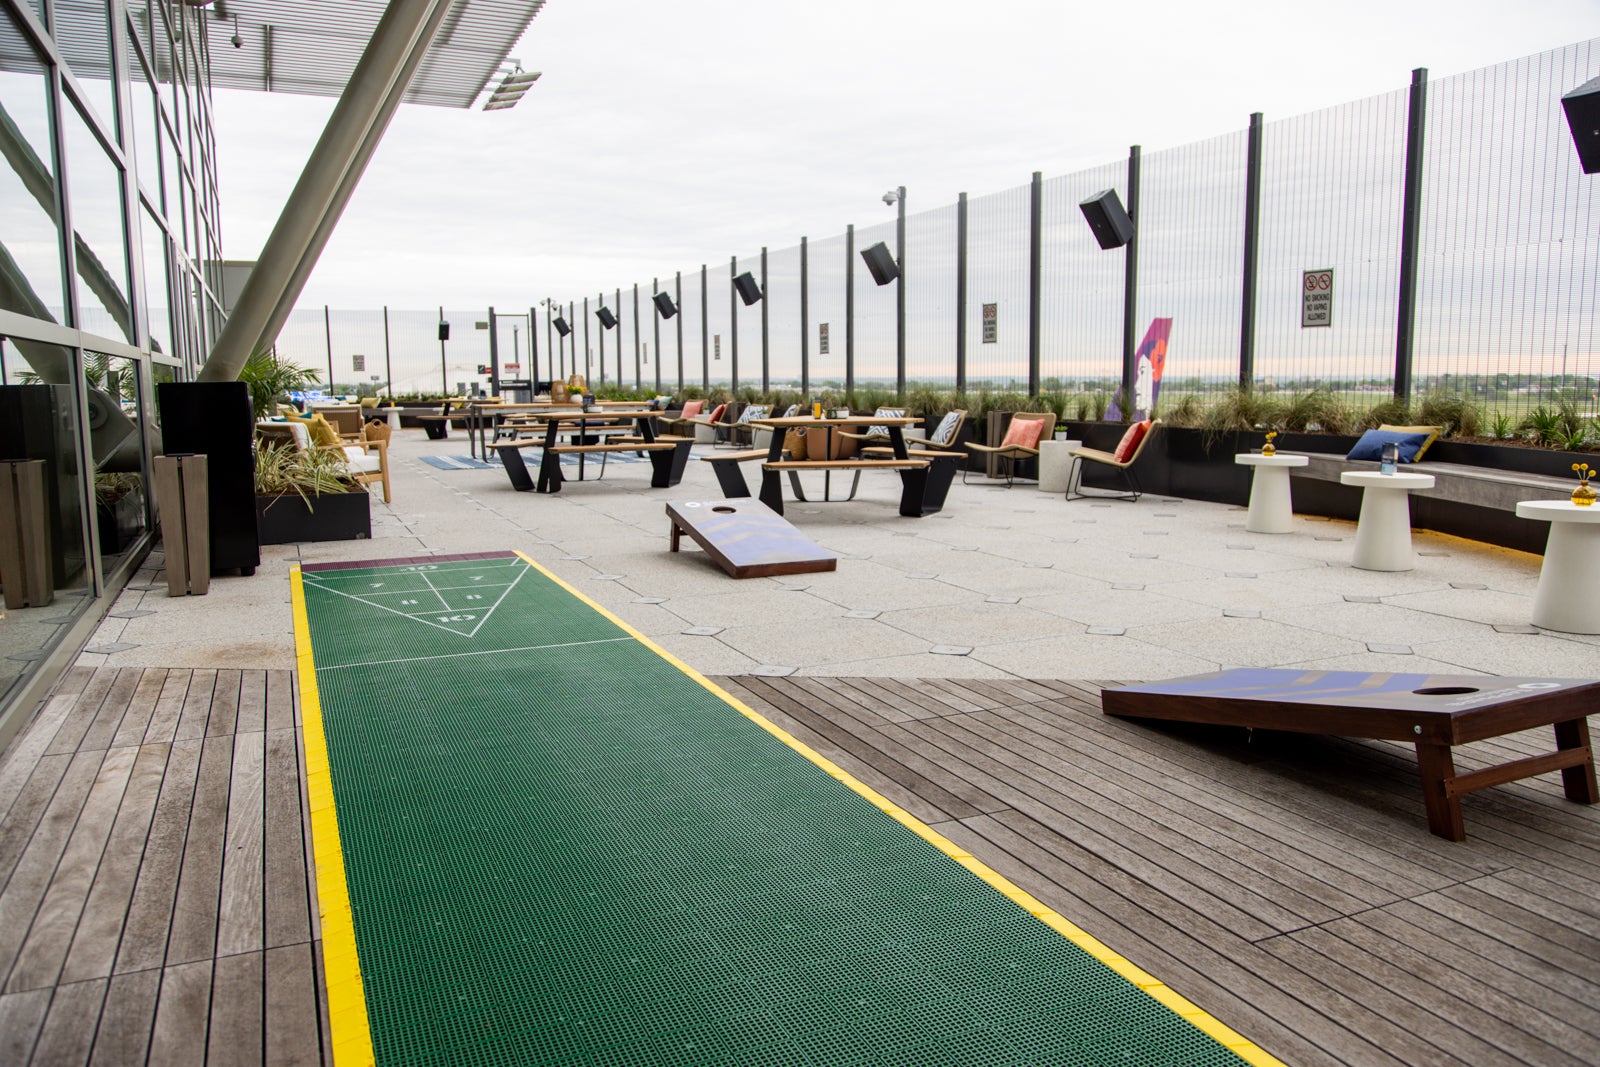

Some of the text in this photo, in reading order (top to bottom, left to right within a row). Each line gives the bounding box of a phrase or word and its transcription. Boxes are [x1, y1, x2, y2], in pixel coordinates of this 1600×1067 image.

[1312, 293, 1329, 302] SMOKING
[1313, 303, 1327, 311] VAPING
[1307, 312, 1326, 320] ALLOWED
[437, 614, 476, 623] 10
